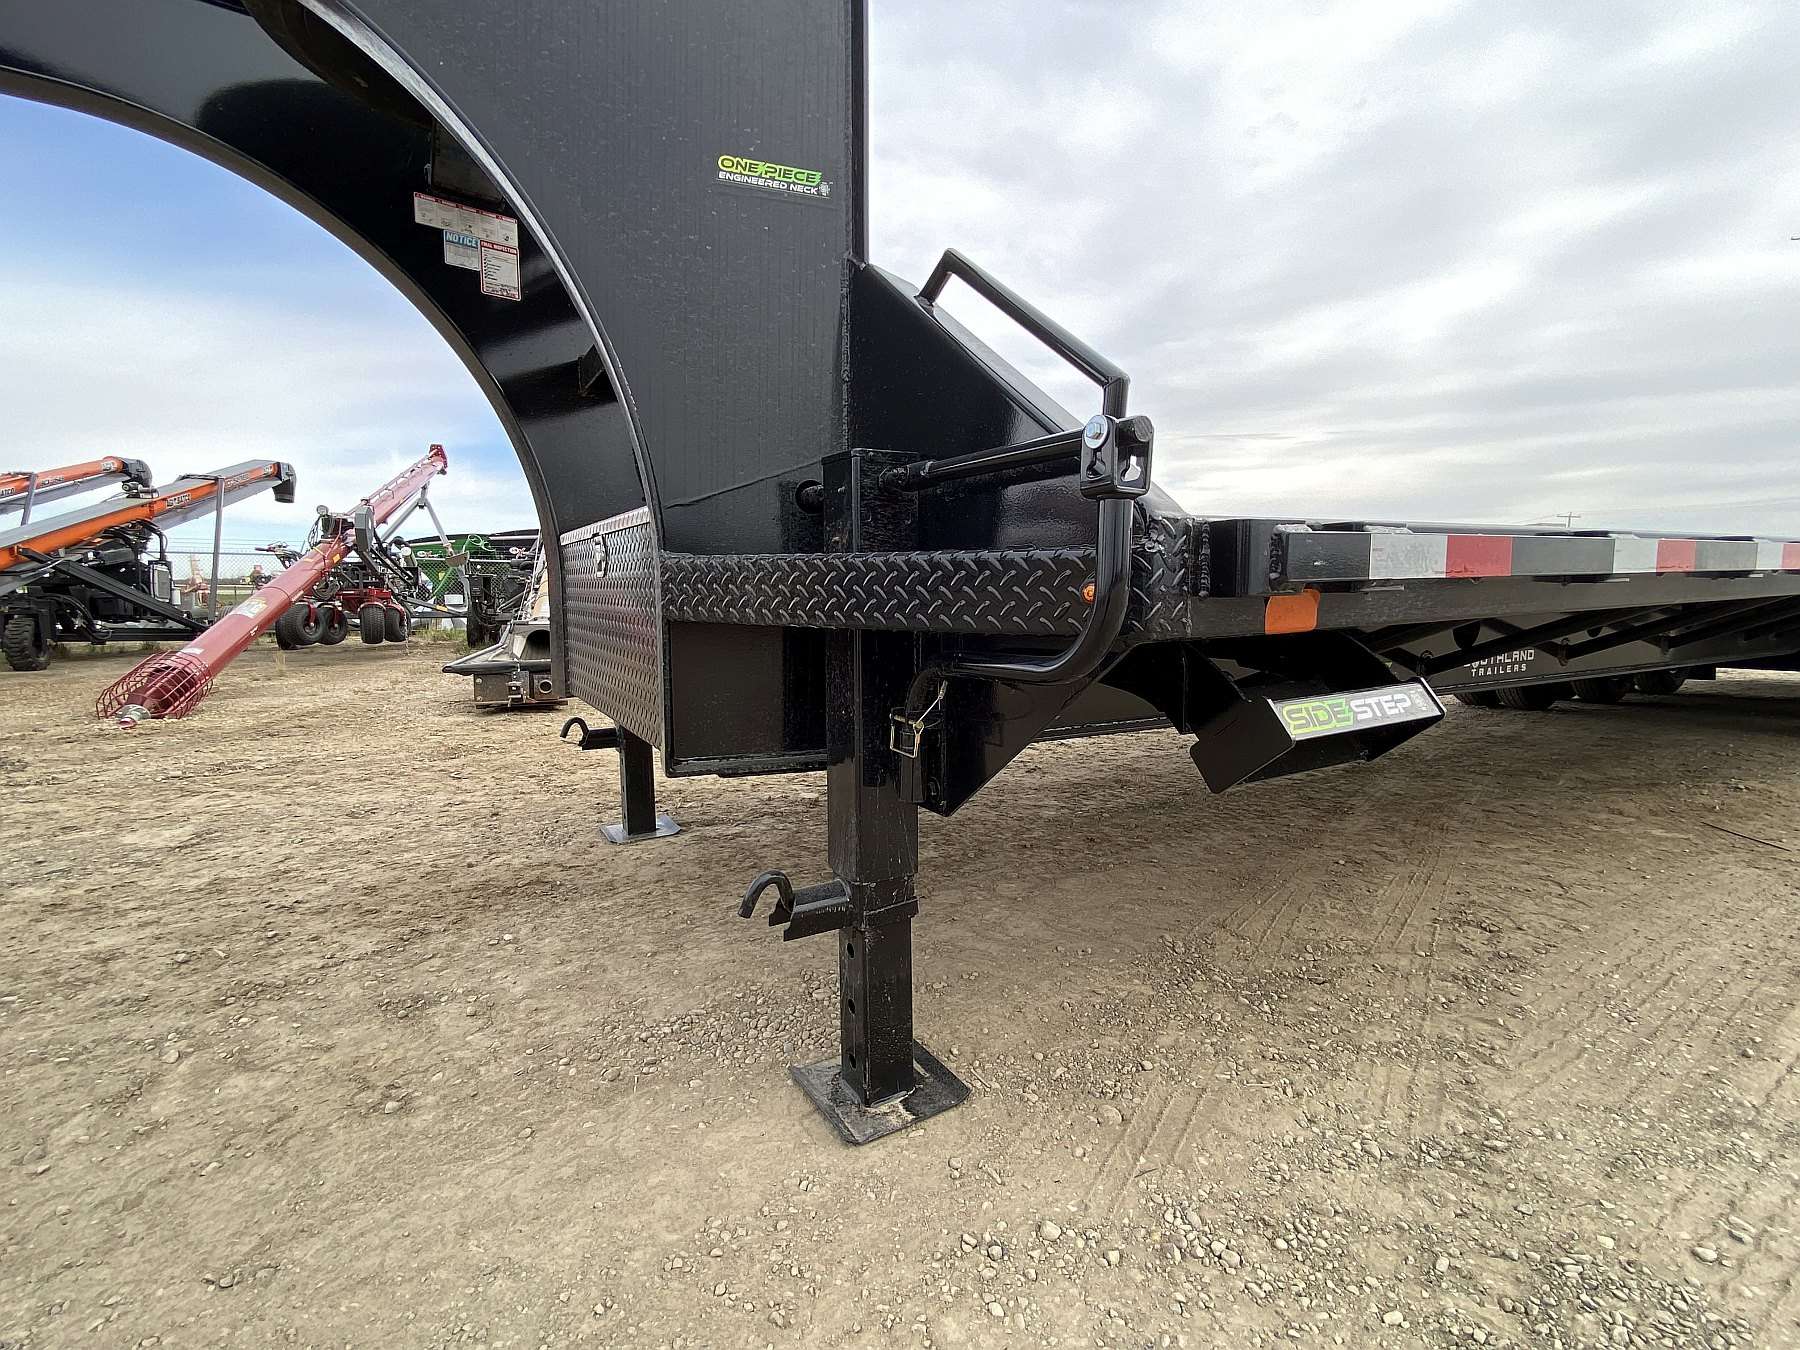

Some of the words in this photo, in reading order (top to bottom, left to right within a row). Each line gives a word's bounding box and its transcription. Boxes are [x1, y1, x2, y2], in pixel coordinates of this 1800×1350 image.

[718, 155, 761, 175] ONE
[762, 162, 821, 185] PIECE
[719, 171, 787, 189] ENGINEERED
[789, 182, 818, 195] NECK
[446, 232, 477, 247] NOTICE
[1463, 649, 1535, 668] OUTHLAND
[1471, 663, 1527, 677] TRAILERS
[1283, 698, 1353, 734] SIDE
[1350, 693, 1411, 720] STEP
